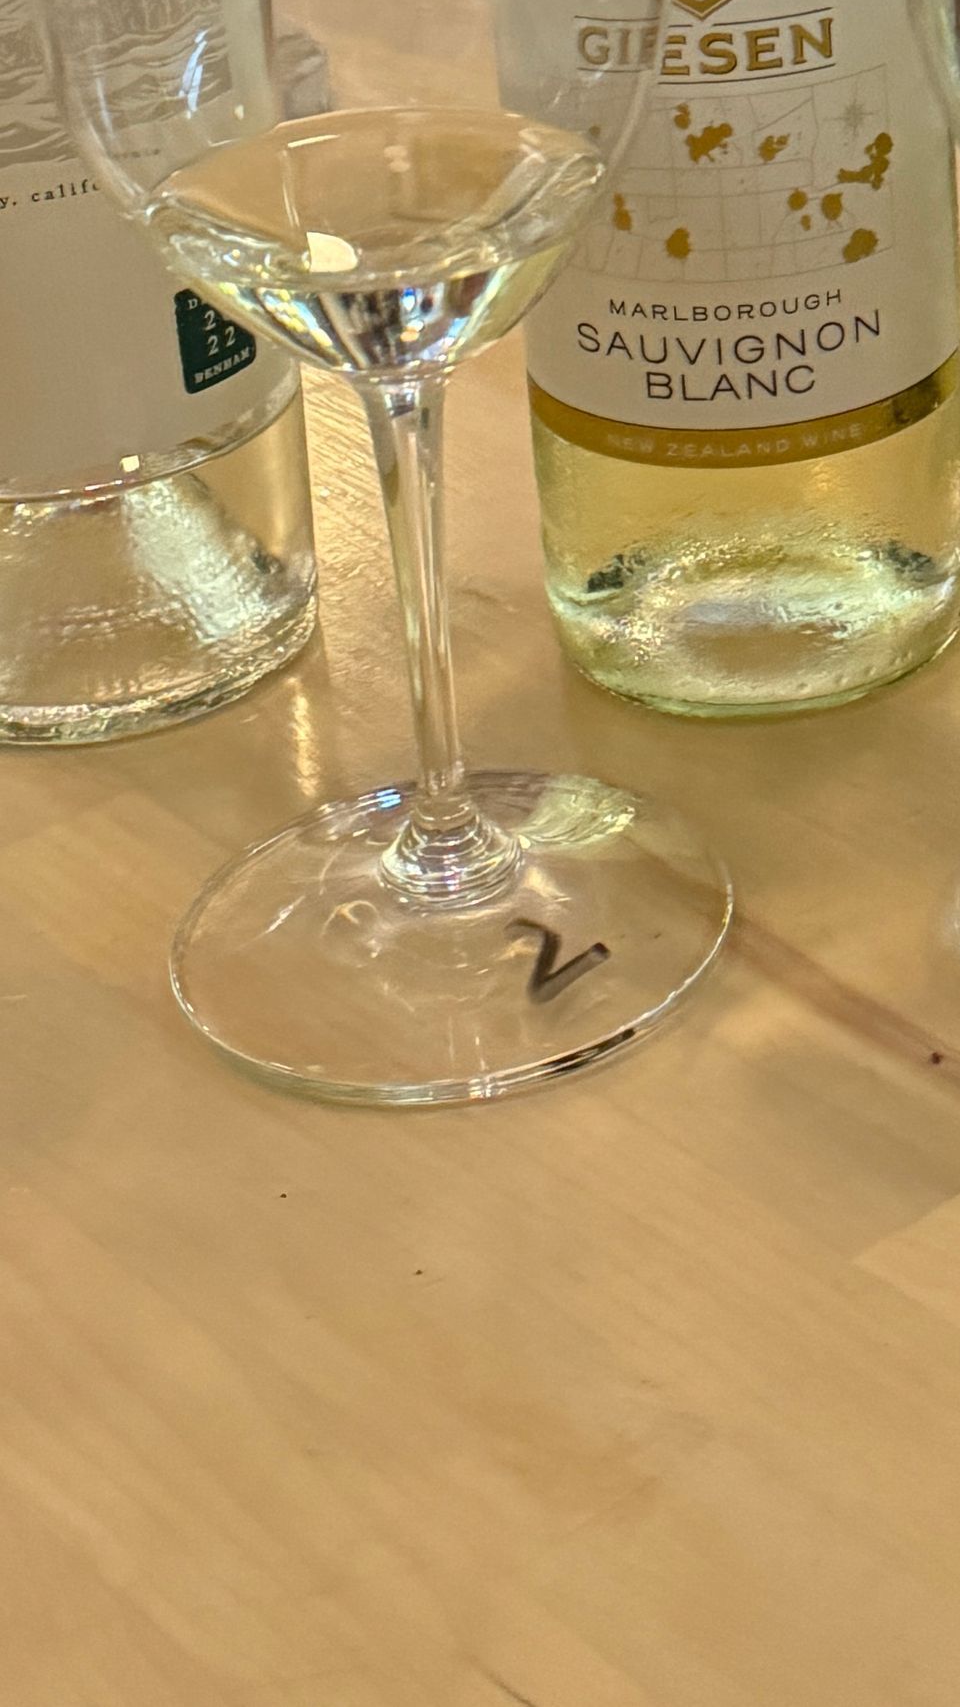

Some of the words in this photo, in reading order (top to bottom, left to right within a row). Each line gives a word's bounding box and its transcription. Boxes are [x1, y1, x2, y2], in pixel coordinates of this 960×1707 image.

[577, 17, 833, 76] GIESEN
[608, 288, 842, 322] MARLBOROUGH
[576, 308, 881, 366] SAUVIGNON
[645, 364, 816, 402] BLANC
[606, 433, 655, 455] NEW
[665, 438, 790, 458] ZEALAND
[802, 422, 865, 448] WINE
[503, 917, 612, 1006] 2
